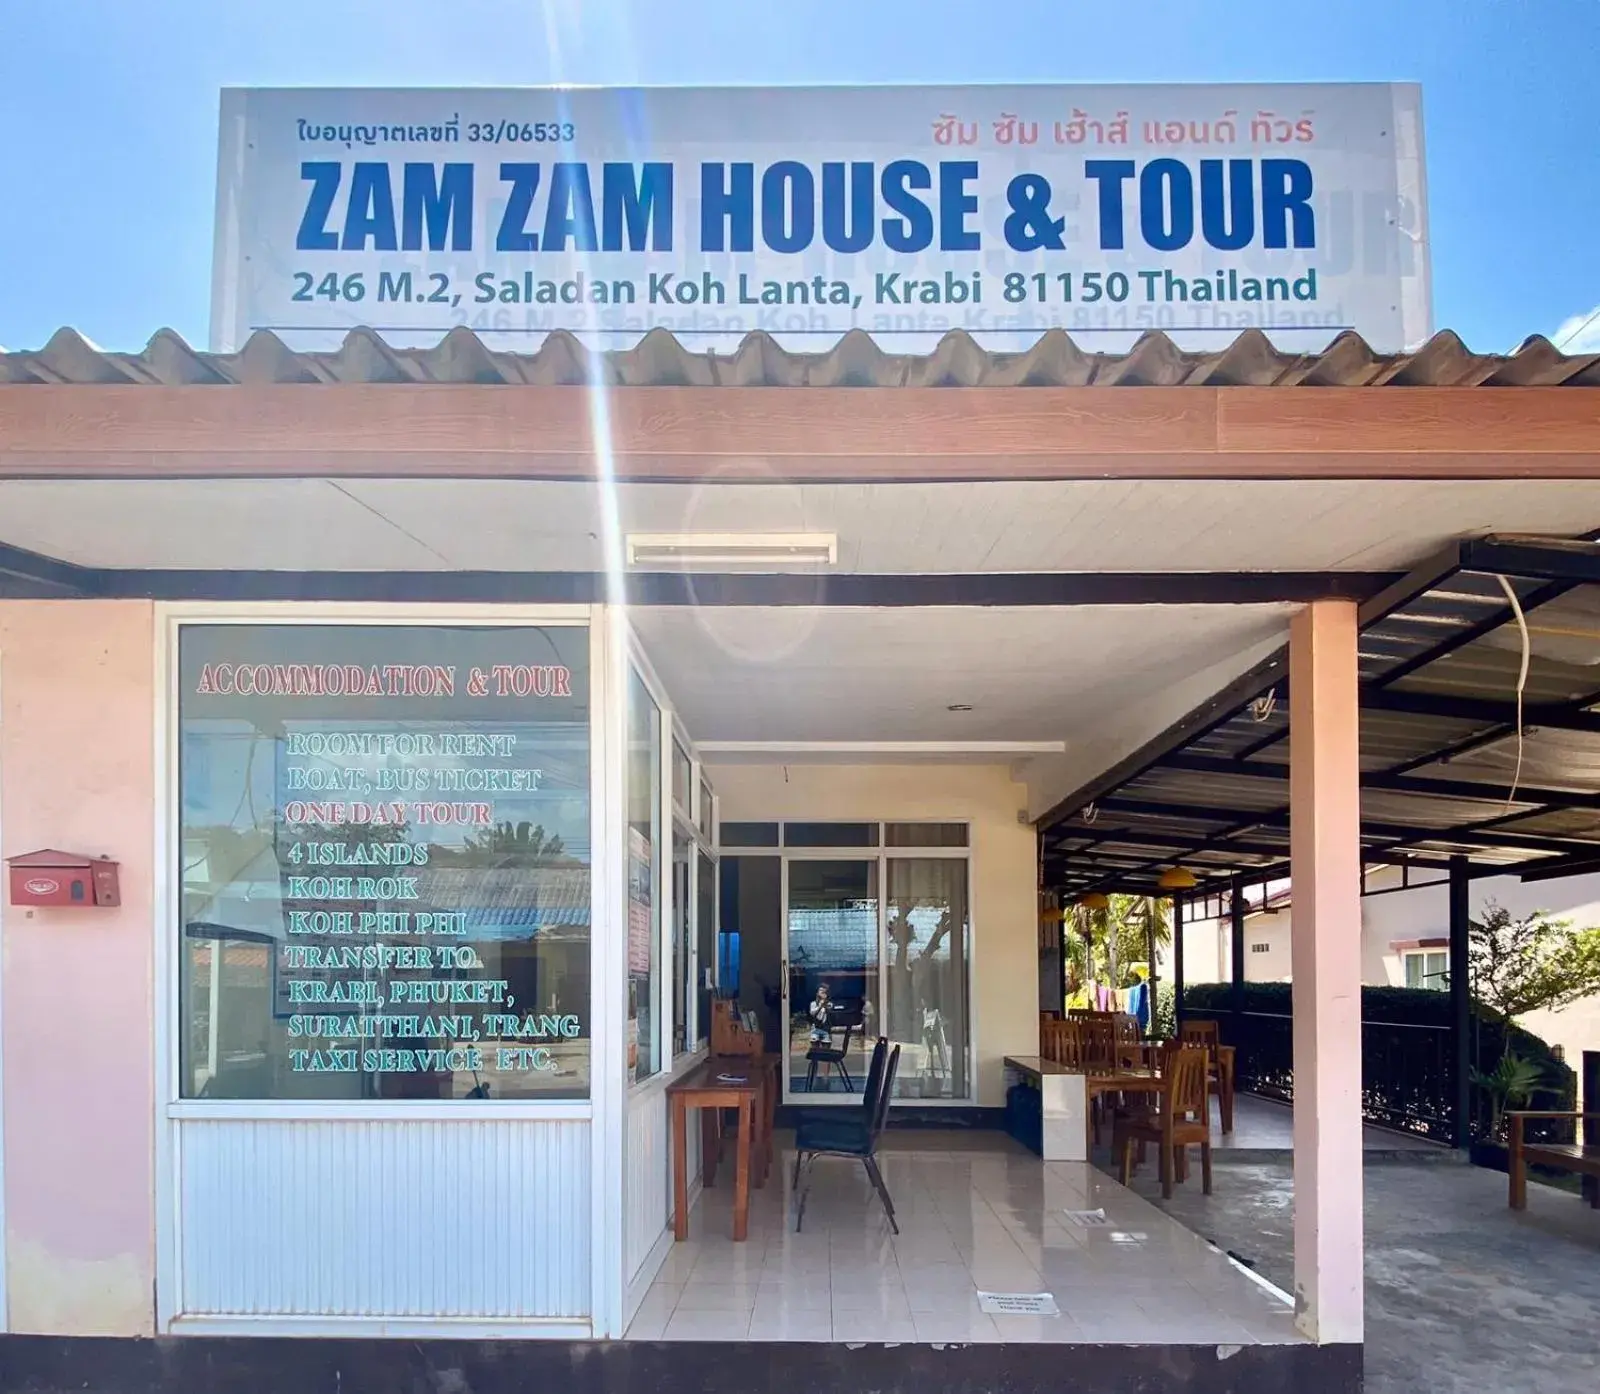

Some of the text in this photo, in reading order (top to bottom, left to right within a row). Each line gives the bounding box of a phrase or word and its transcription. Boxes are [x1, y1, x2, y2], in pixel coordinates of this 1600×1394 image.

[297, 113, 575, 149] ใบอนุญาตเลขที่ 33/06533
[1054, 108, 1129, 144] เฮ้าส์
[1143, 110, 1239, 144] แอนด์
[1251, 110, 1316, 143] ทัวร์
[296, 161, 474, 251] ZAM
[496, 162, 673, 252] ZAM
[701, 160, 981, 253] HOUSE
[1003, 172, 1067, 252] &
[1084, 158, 1316, 251] TOUR
[291, 268, 1318, 309] 246 M.2, Saladan Koh Lanta, Krabi 81150 Thailand
[197, 664, 572, 697] ACCOMMODATION & TOUR
[287, 733, 516, 758] ROOM FOR RENT
[287, 767, 541, 795] BOAT, BUS TICKET
[286, 801, 493, 825] ONE DAY TOUR
[287, 842, 428, 866] 4 ISLANDS
[288, 877, 419, 900] KOH ROK
[288, 911, 467, 935] KOH PHI PHI
[285, 946, 439, 969] TRANSFER
[288, 980, 516, 1008] KRABI, PHUKET,
[288, 1014, 581, 1042] SURATTHANI, TRANG
[288, 1048, 559, 1072] TAXI SERVICE ETC.
